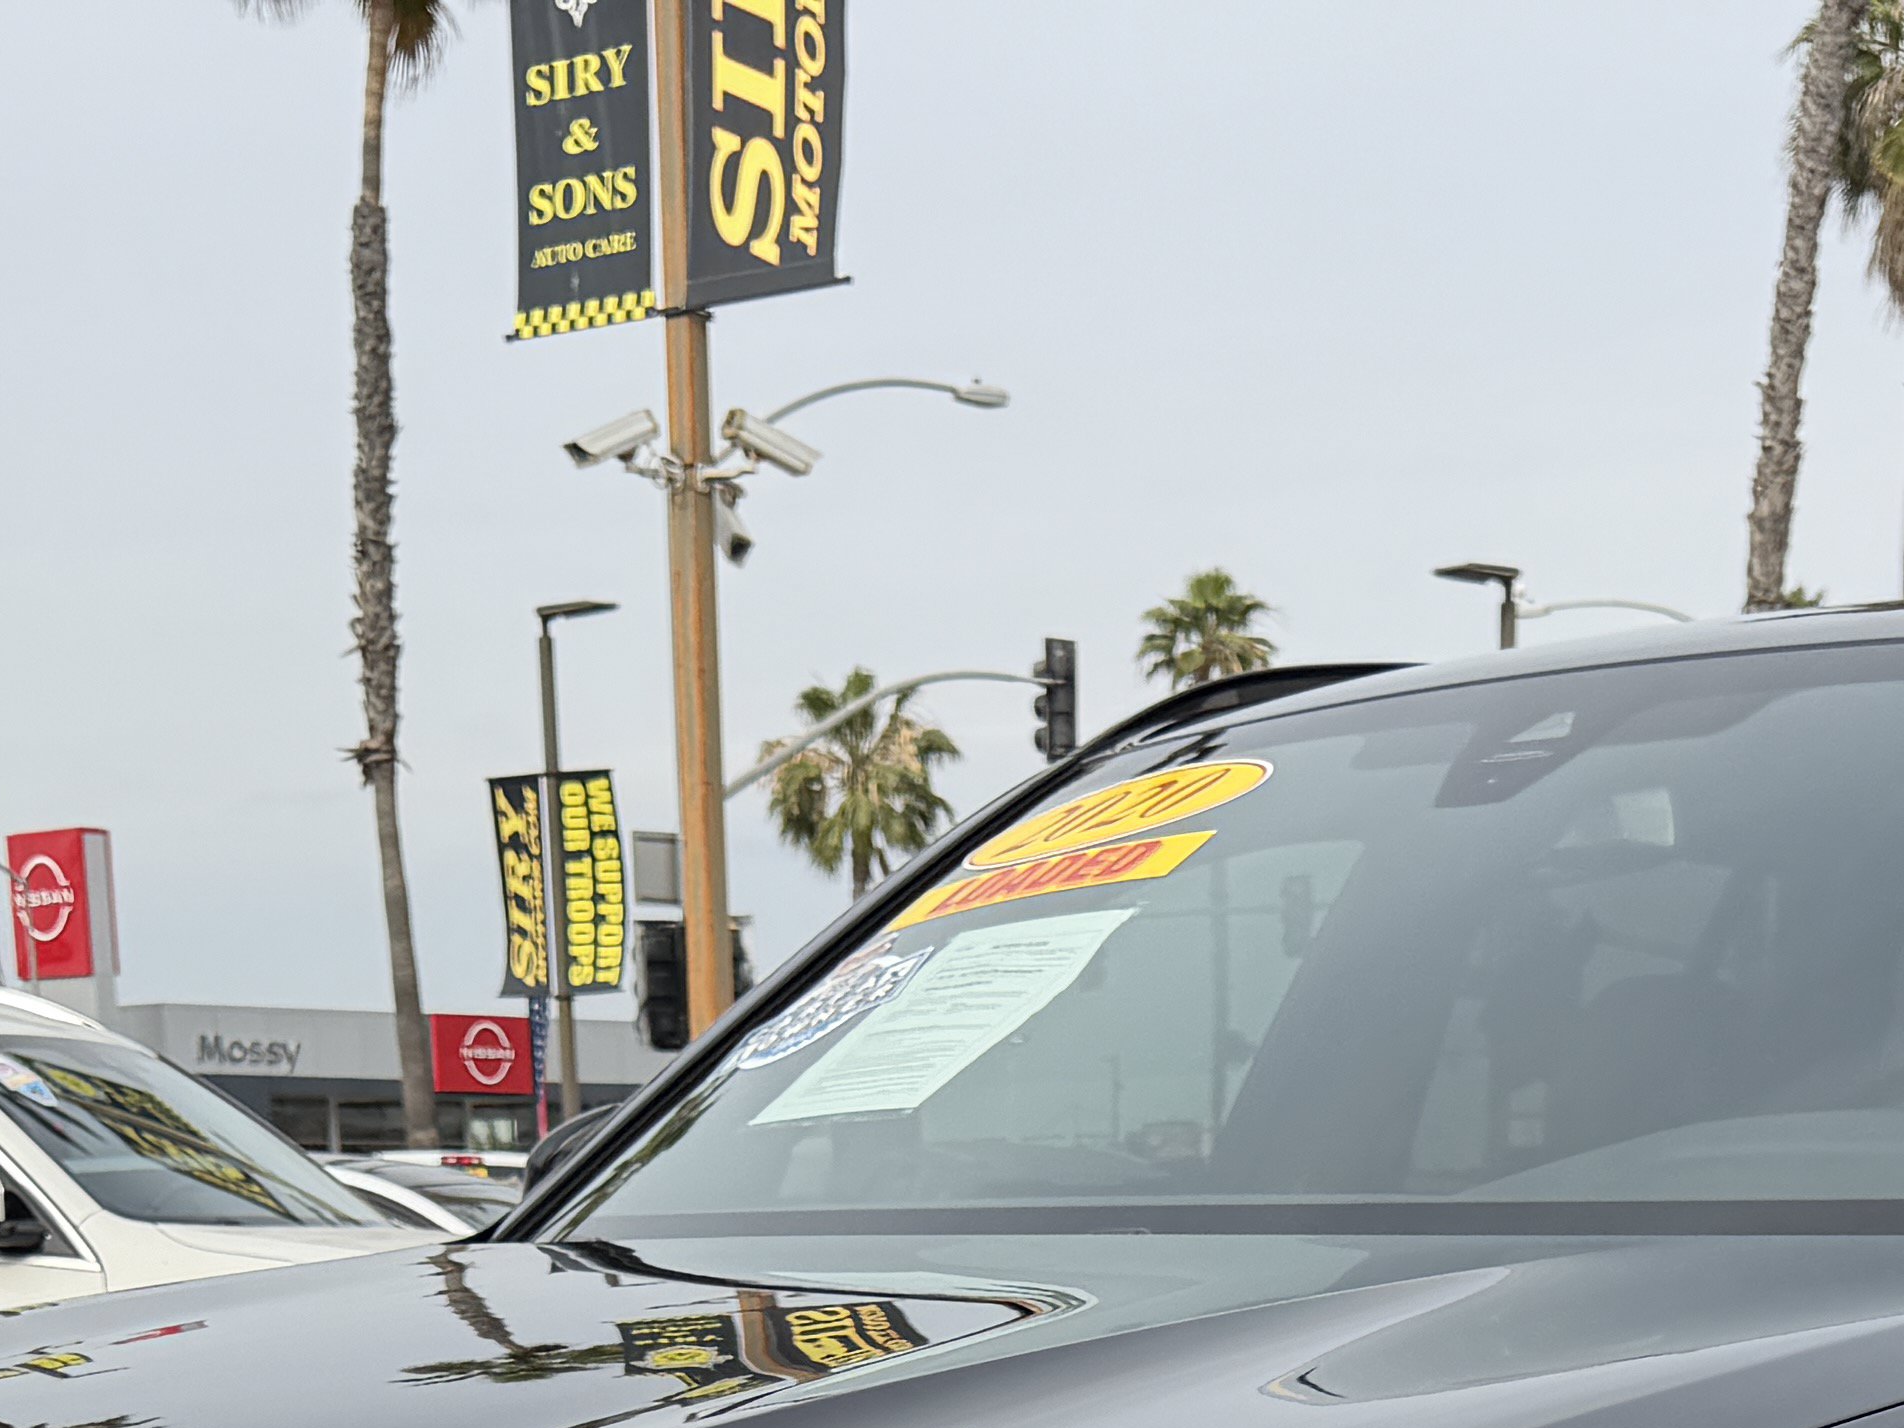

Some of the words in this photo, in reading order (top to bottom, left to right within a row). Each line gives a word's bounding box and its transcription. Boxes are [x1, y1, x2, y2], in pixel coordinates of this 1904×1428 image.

[526, 44, 633, 107] SIRY
[562, 117, 599, 155] &
[528, 165, 637, 226] SONS
[531, 237, 585, 269] AUTO
[586, 230, 637, 260] CARE
[559, 780, 591, 852] OUR
[585, 777, 617, 832] WE
[991, 768, 1232, 859] 2020
[494, 785, 538, 987] SIRY
[592, 835, 624, 986] SUPPORT
[926, 841, 1163, 918] LOADED
[564, 856, 595, 987] TROOPS
[198, 1032, 301, 1075] Mossy
